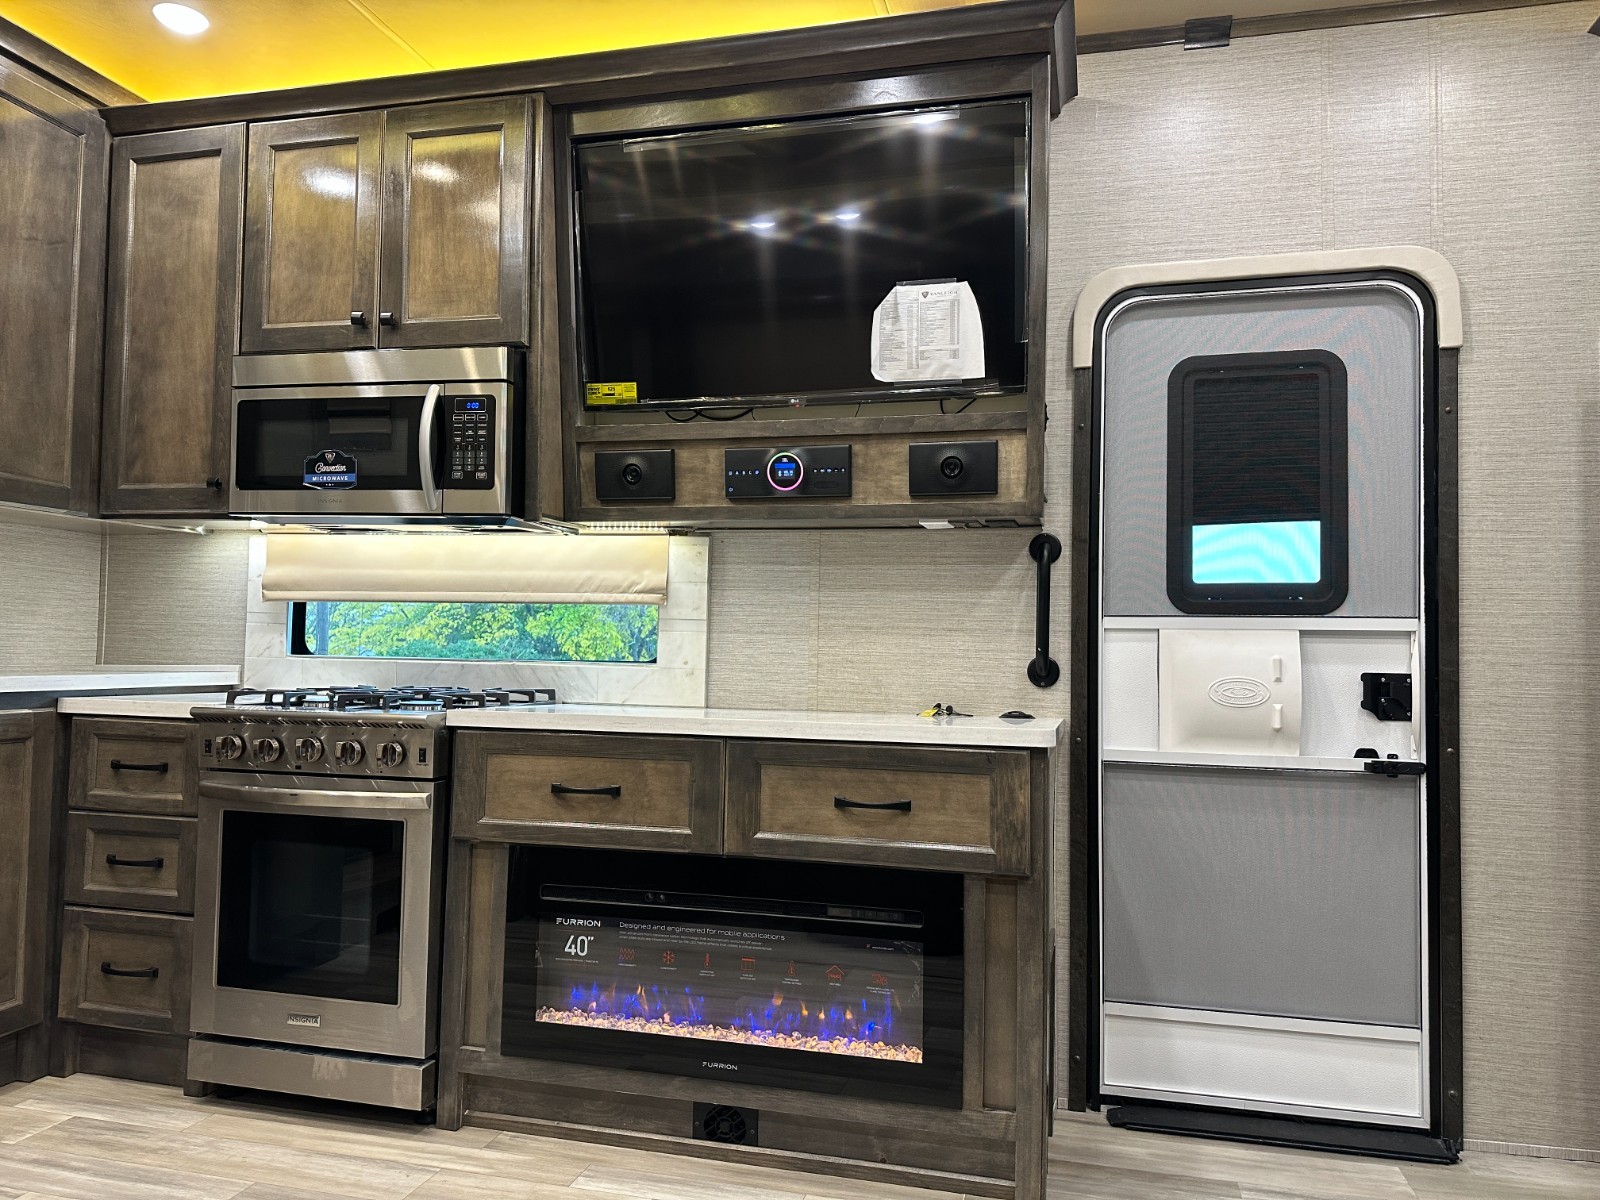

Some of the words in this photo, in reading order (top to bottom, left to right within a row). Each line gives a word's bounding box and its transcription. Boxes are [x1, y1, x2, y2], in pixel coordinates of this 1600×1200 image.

[315, 462, 347, 473] Convection
[556, 918, 601, 928] FURRION
[619, 921, 651, 930] Designed
[666, 926, 706, 934] engineered
[717, 929, 741, 937] mobile
[742, 931, 786, 941] applications
[702, 1061, 738, 1071] FURRION
